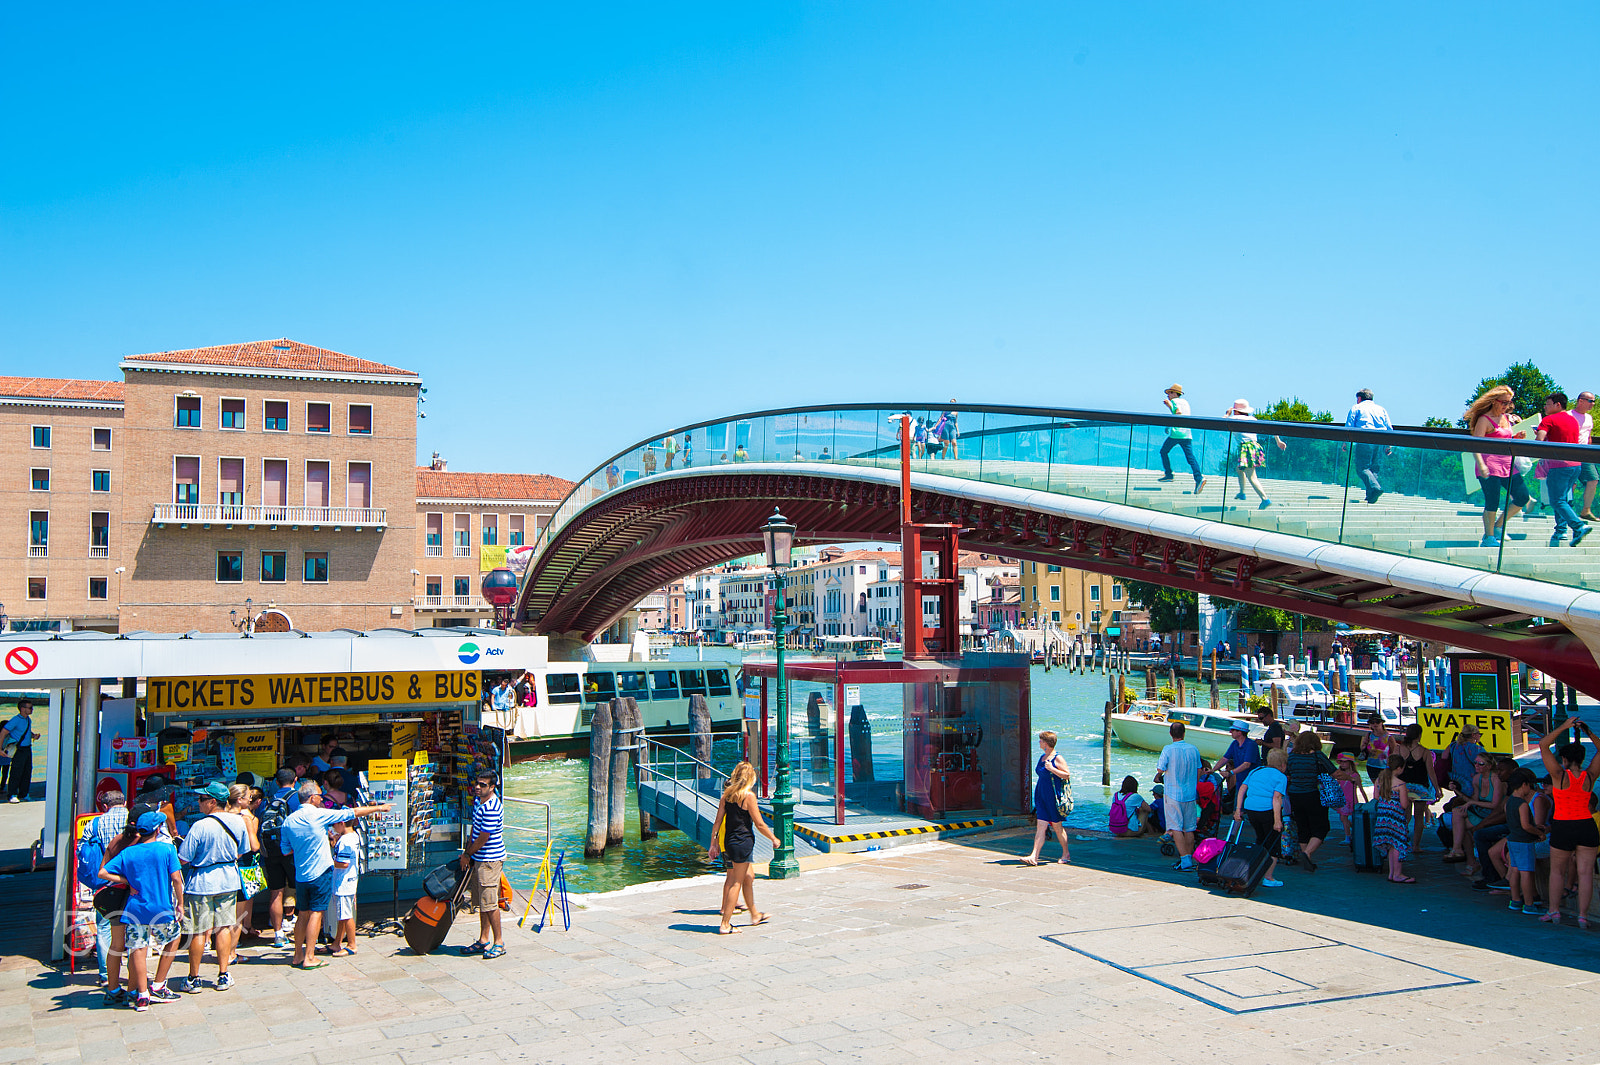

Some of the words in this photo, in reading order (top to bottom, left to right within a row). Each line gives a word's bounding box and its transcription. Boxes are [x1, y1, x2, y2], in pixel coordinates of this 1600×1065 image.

[485, 647, 505, 656] Actv
[152, 679, 254, 708] TICKETS
[269, 675, 394, 704] WATERBUS
[408, 674, 421, 699] &
[435, 672, 477, 698] BUS
[1423, 713, 1506, 731] WATER
[393, 724, 406, 733] QUI
[246, 735, 266, 743] QUI
[238, 744, 274, 752] TICKETS
